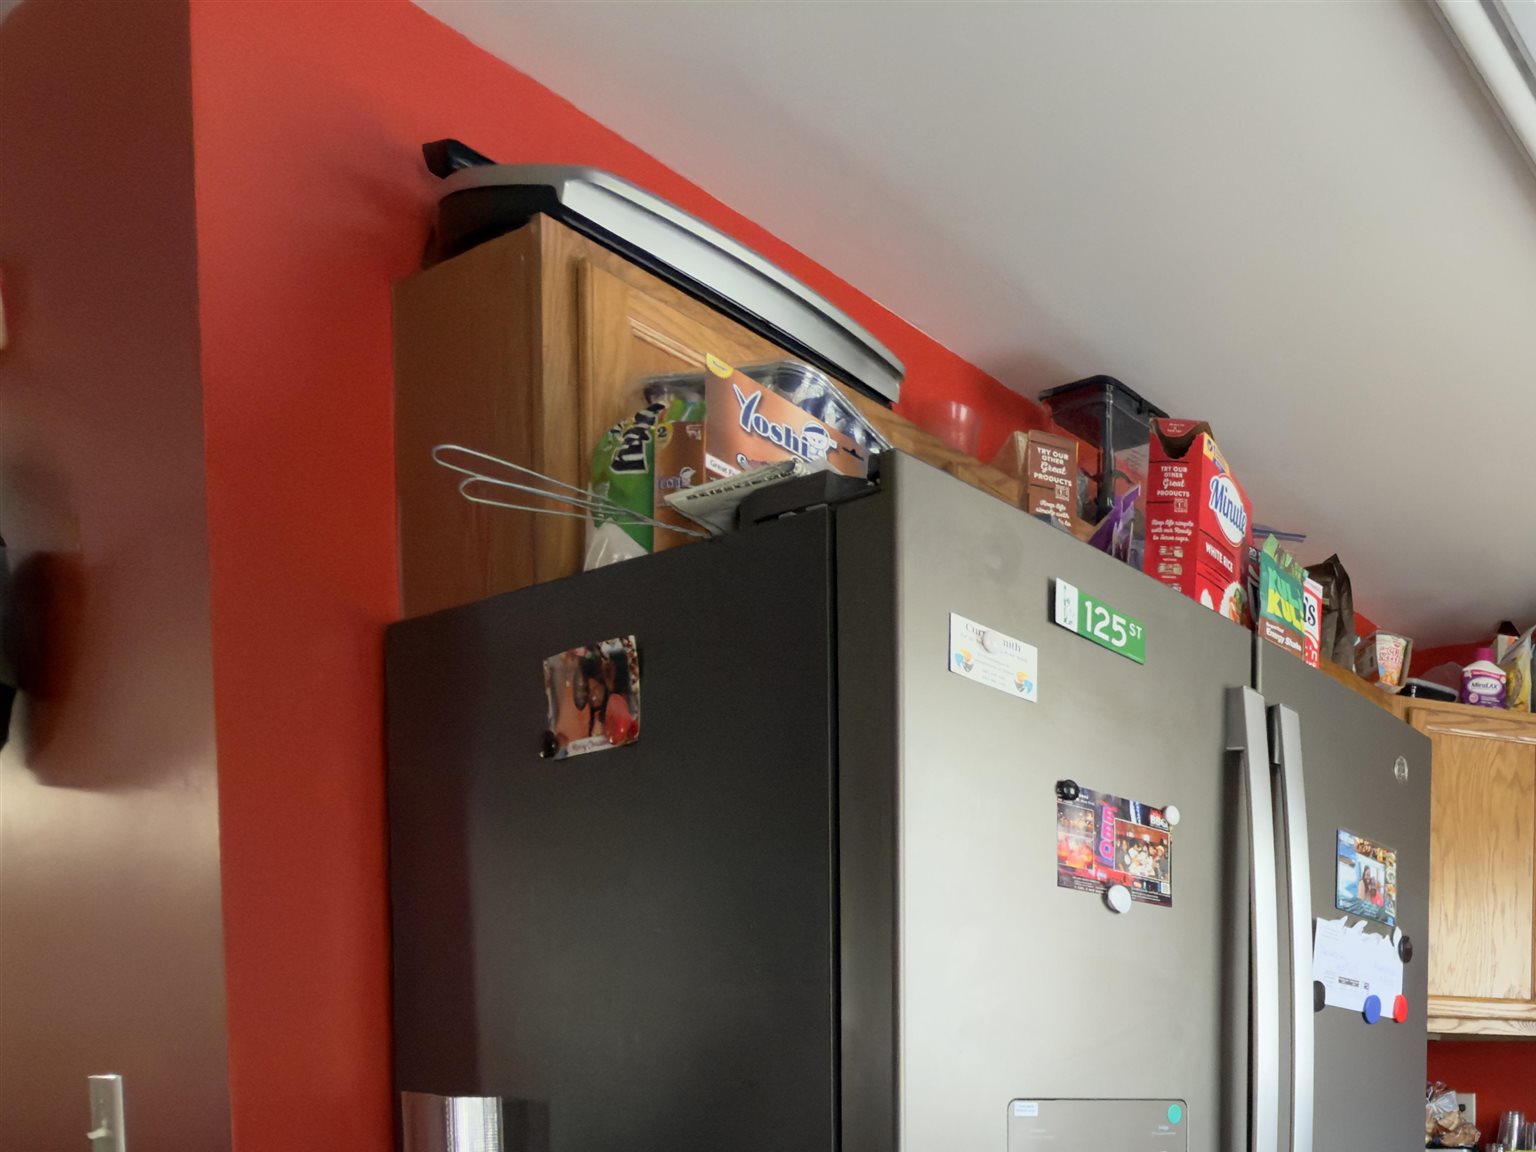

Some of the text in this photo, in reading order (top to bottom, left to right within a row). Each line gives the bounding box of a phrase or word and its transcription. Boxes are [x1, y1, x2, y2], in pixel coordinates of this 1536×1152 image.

[731, 382, 812, 462] Yoshi
[1036, 446, 1069, 460] TRY OUR
[1041, 455, 1065, 465] OTHER
[1040, 460, 1067, 475] Great
[1160, 465, 1171, 473] TRY
[1033, 472, 1072, 487] PRODUCTS
[1162, 478, 1186, 490] Great
[1156, 490, 1190, 498] PRODUCTS
[1210, 477, 1248, 536] Minute
[1205, 541, 1223, 565] WHITE
[1223, 555, 1233, 574] RICE
[1085, 600, 1143, 648] 125 ST
